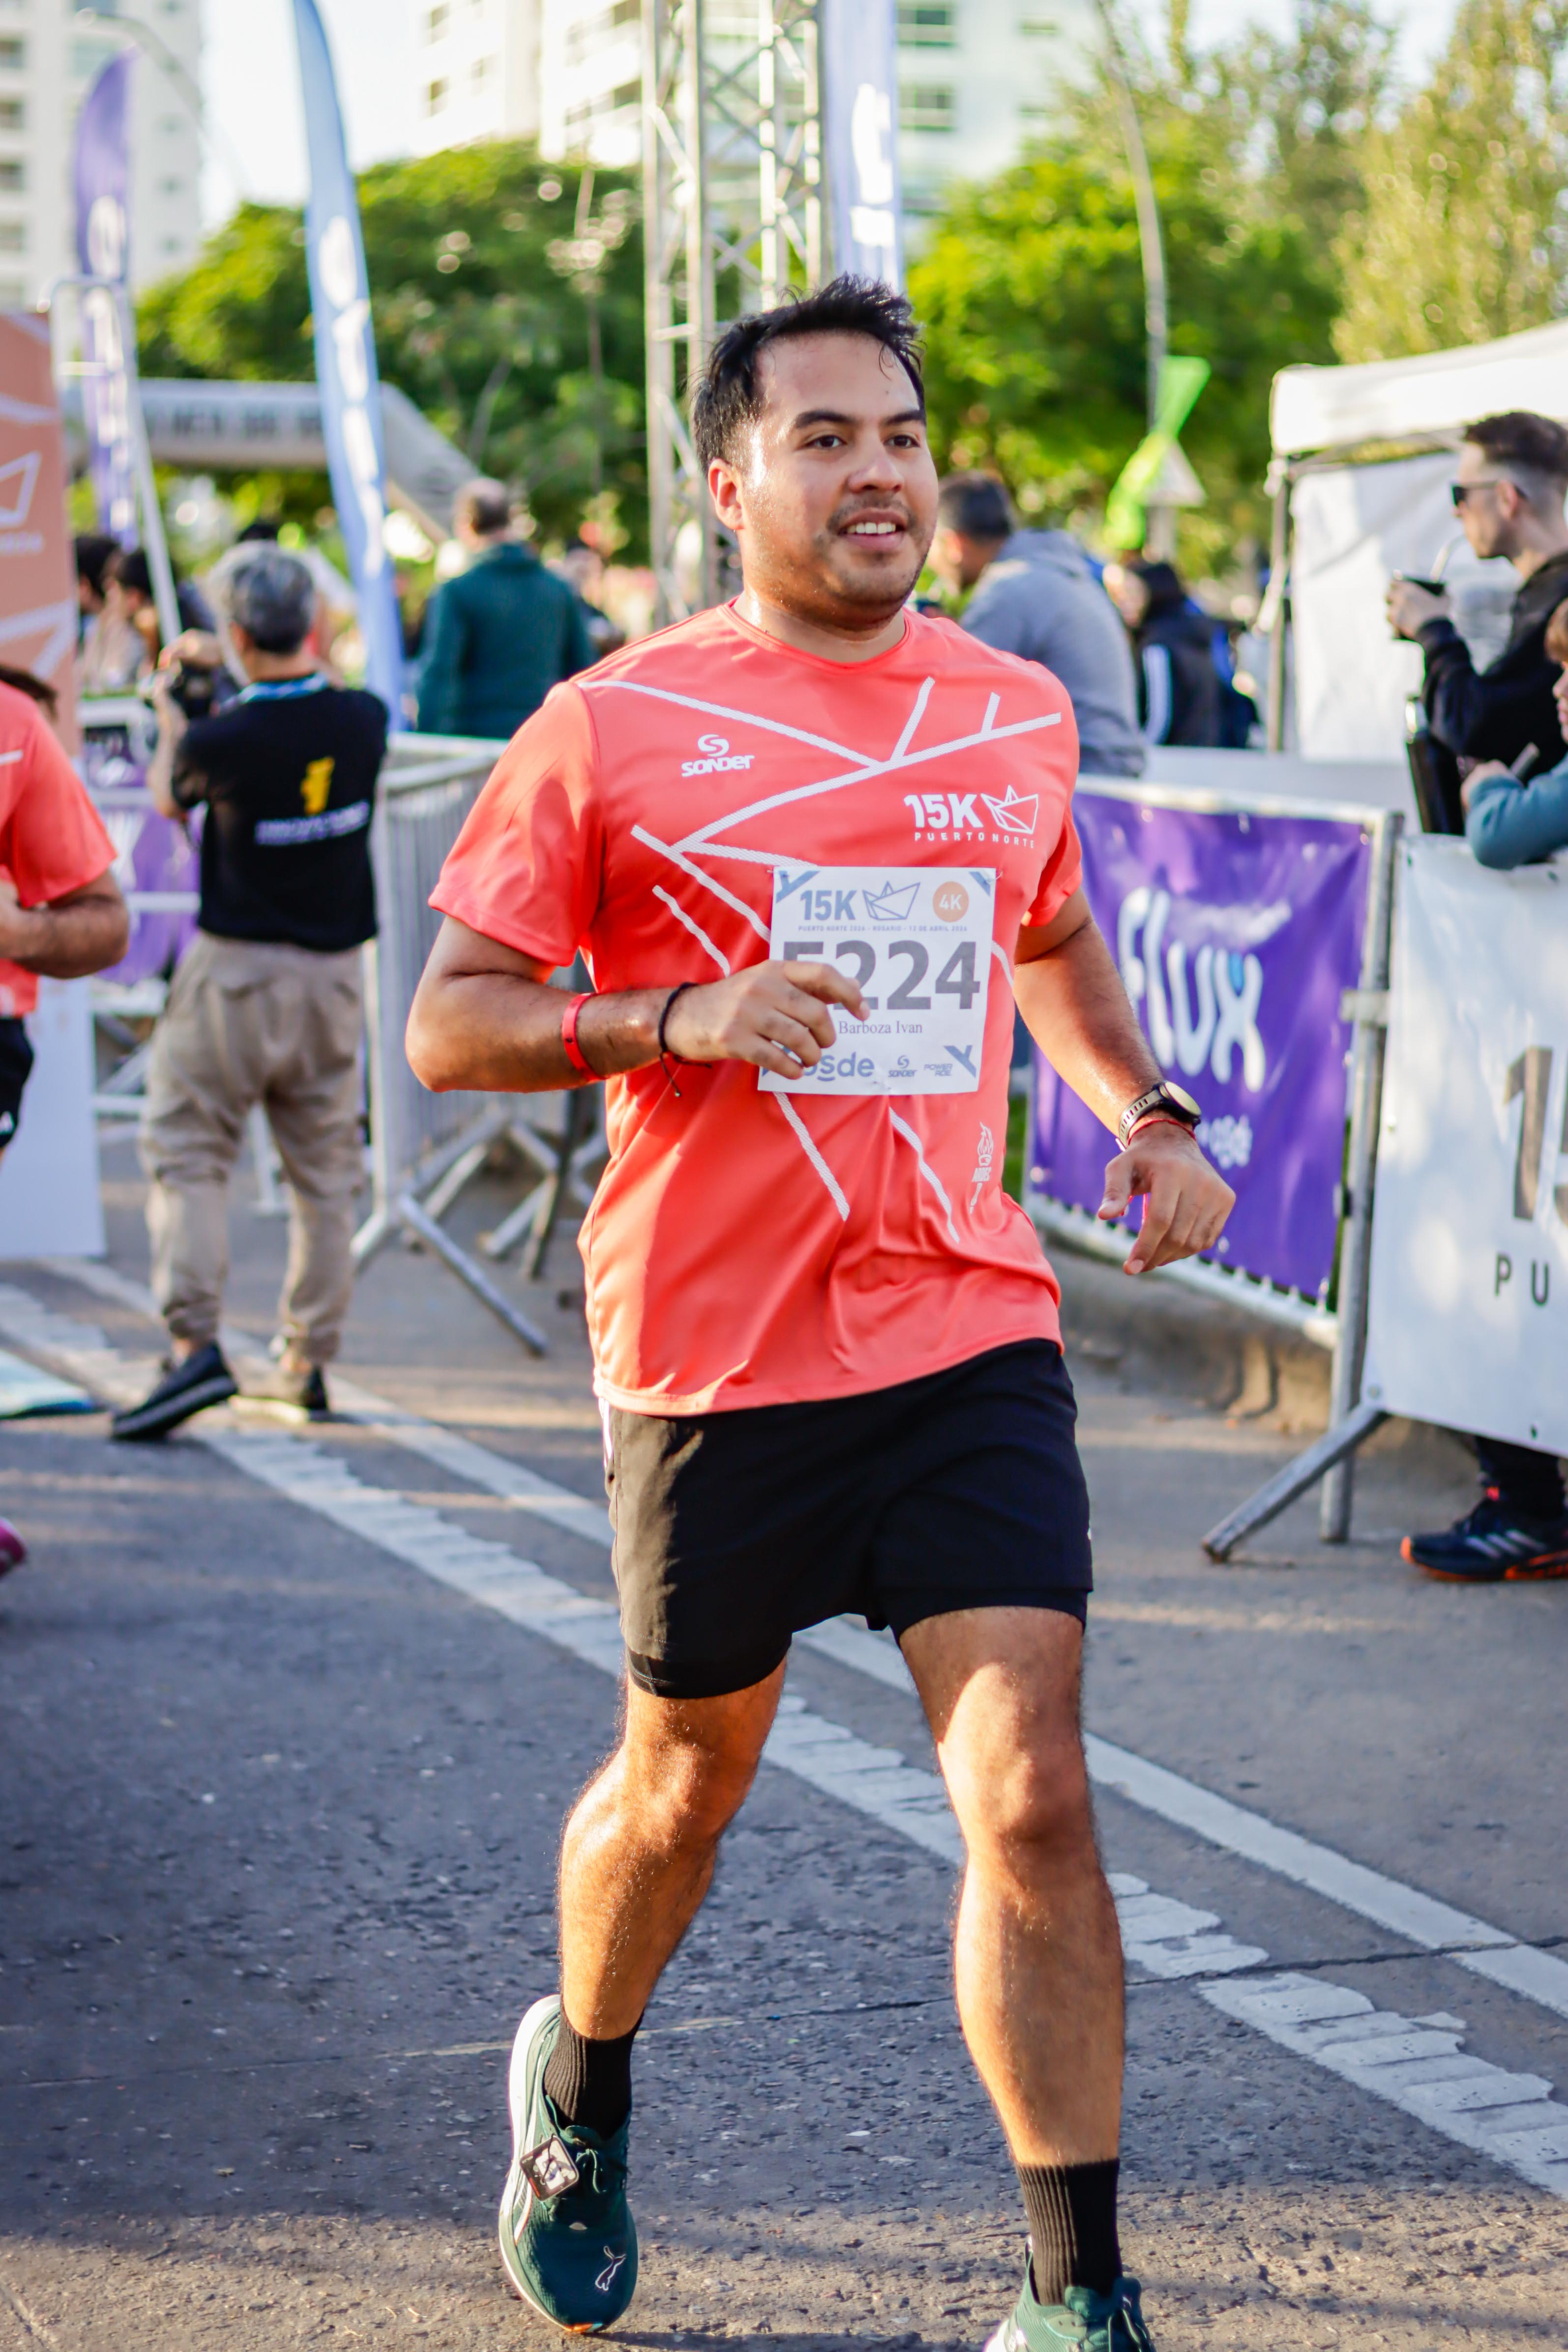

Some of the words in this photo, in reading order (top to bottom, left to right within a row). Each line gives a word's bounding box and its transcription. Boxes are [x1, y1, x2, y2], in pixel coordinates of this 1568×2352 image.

[904, 793, 984, 829] 15K
[915, 832, 985, 842] PUERTO
[992, 833, 1035, 849] NORTE
[799, 890, 857, 921] 15K
[939, 893, 962, 911] 4K
[783, 940, 981, 1010] 224
[838, 1020, 891, 1034] Barboza
[896, 1020, 923, 1034] Ivan
